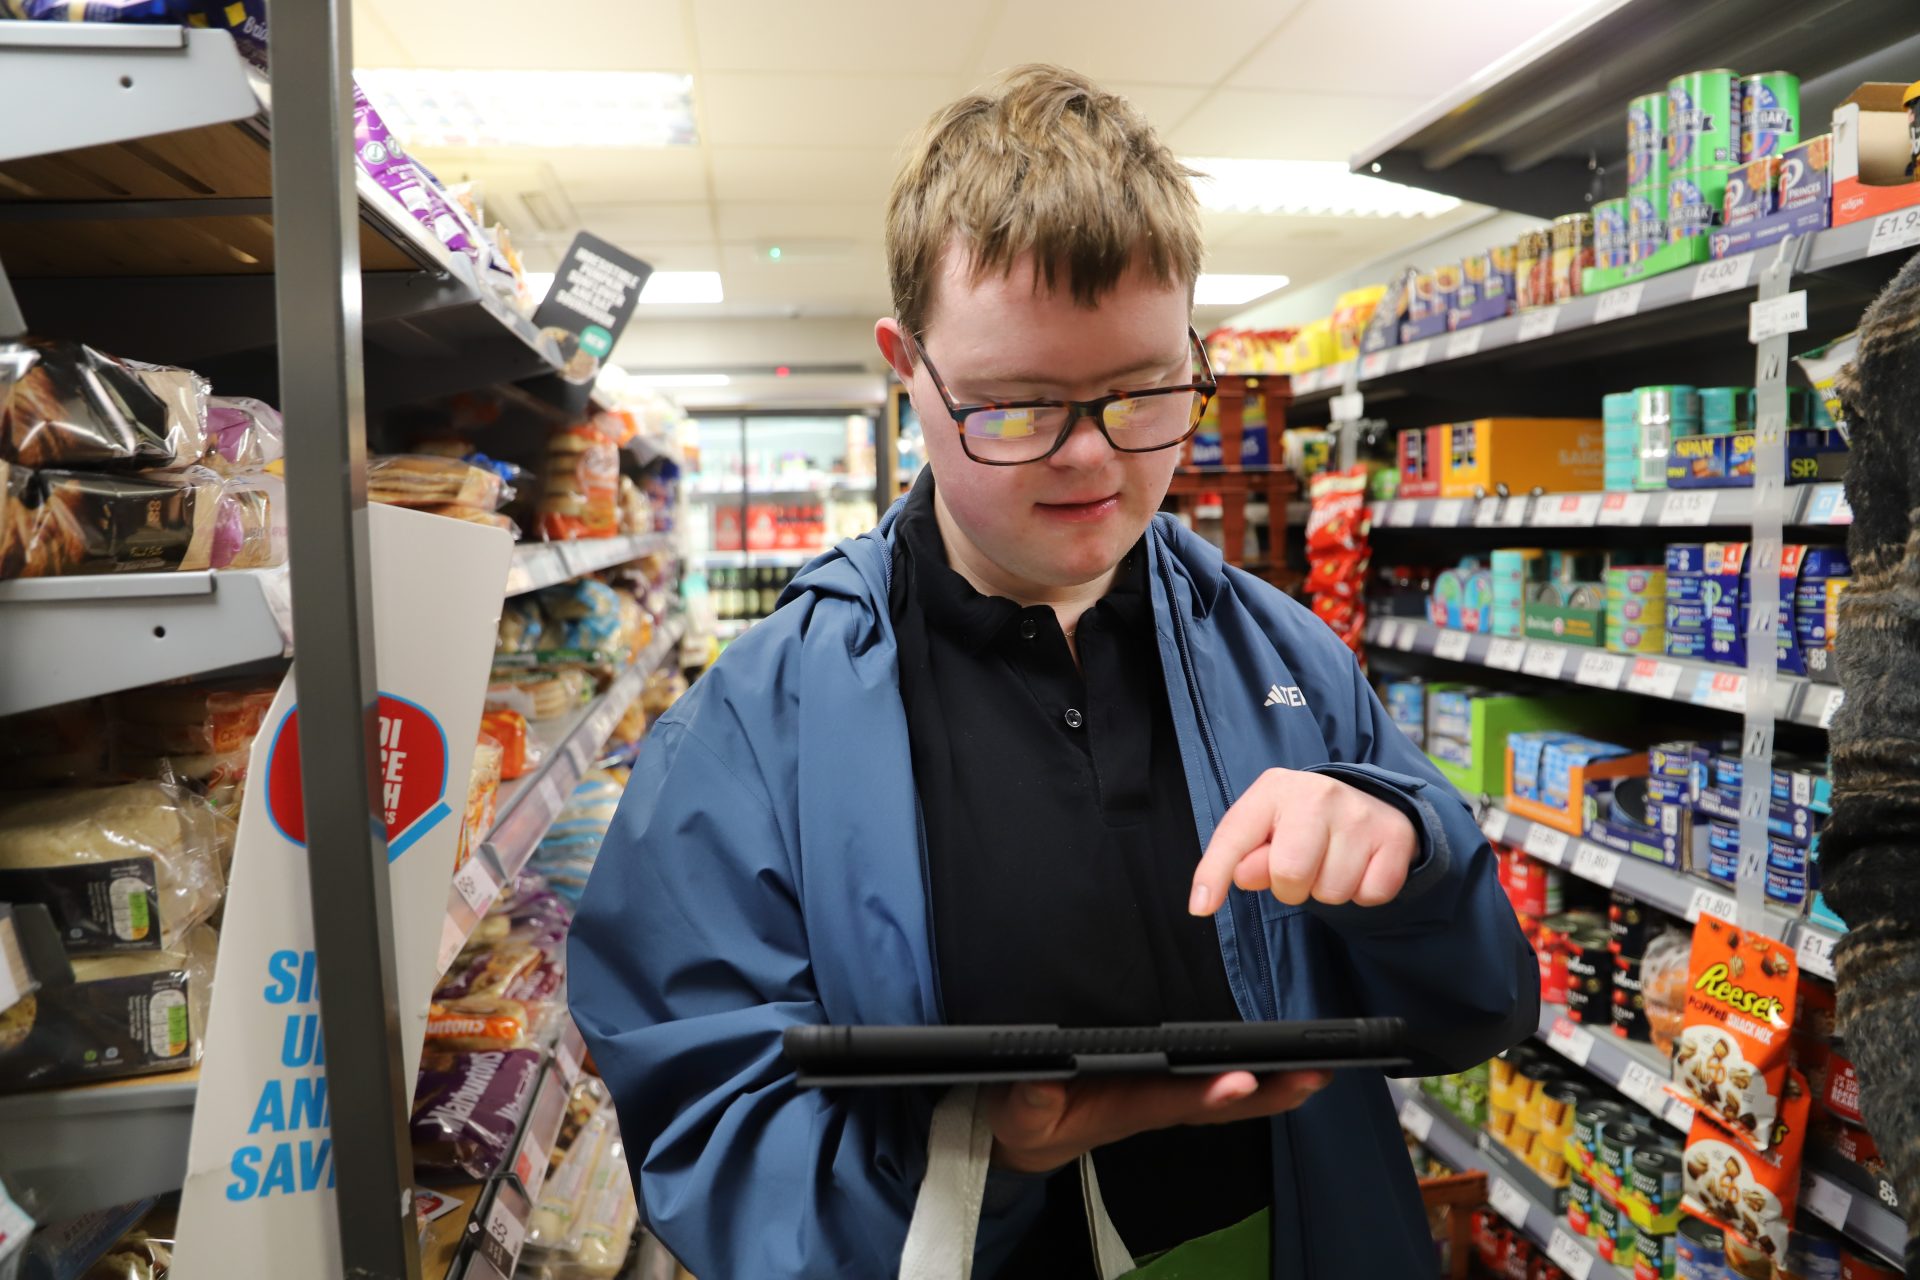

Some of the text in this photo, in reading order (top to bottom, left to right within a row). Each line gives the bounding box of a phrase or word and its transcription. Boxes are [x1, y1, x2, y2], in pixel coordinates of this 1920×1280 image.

[1788, 182, 1821, 199] PRINCES
[1675, 437, 1714, 458] SPAM
[1733, 434, 1756, 456] SP
[1790, 457, 1819, 478] SP
[1727, 550, 1737, 562] 4
[1785, 551, 1795, 564] 4
[1695, 891, 1732, 916] £1.80
[1803, 934, 1833, 959] £1.
[263, 948, 321, 1005] SI
[1694, 963, 1785, 1023] Reese's
[1727, 1012, 1755, 1036] SNACK
[1754, 1025, 1774, 1046] MIX
[247, 1076, 333, 1135] AN
